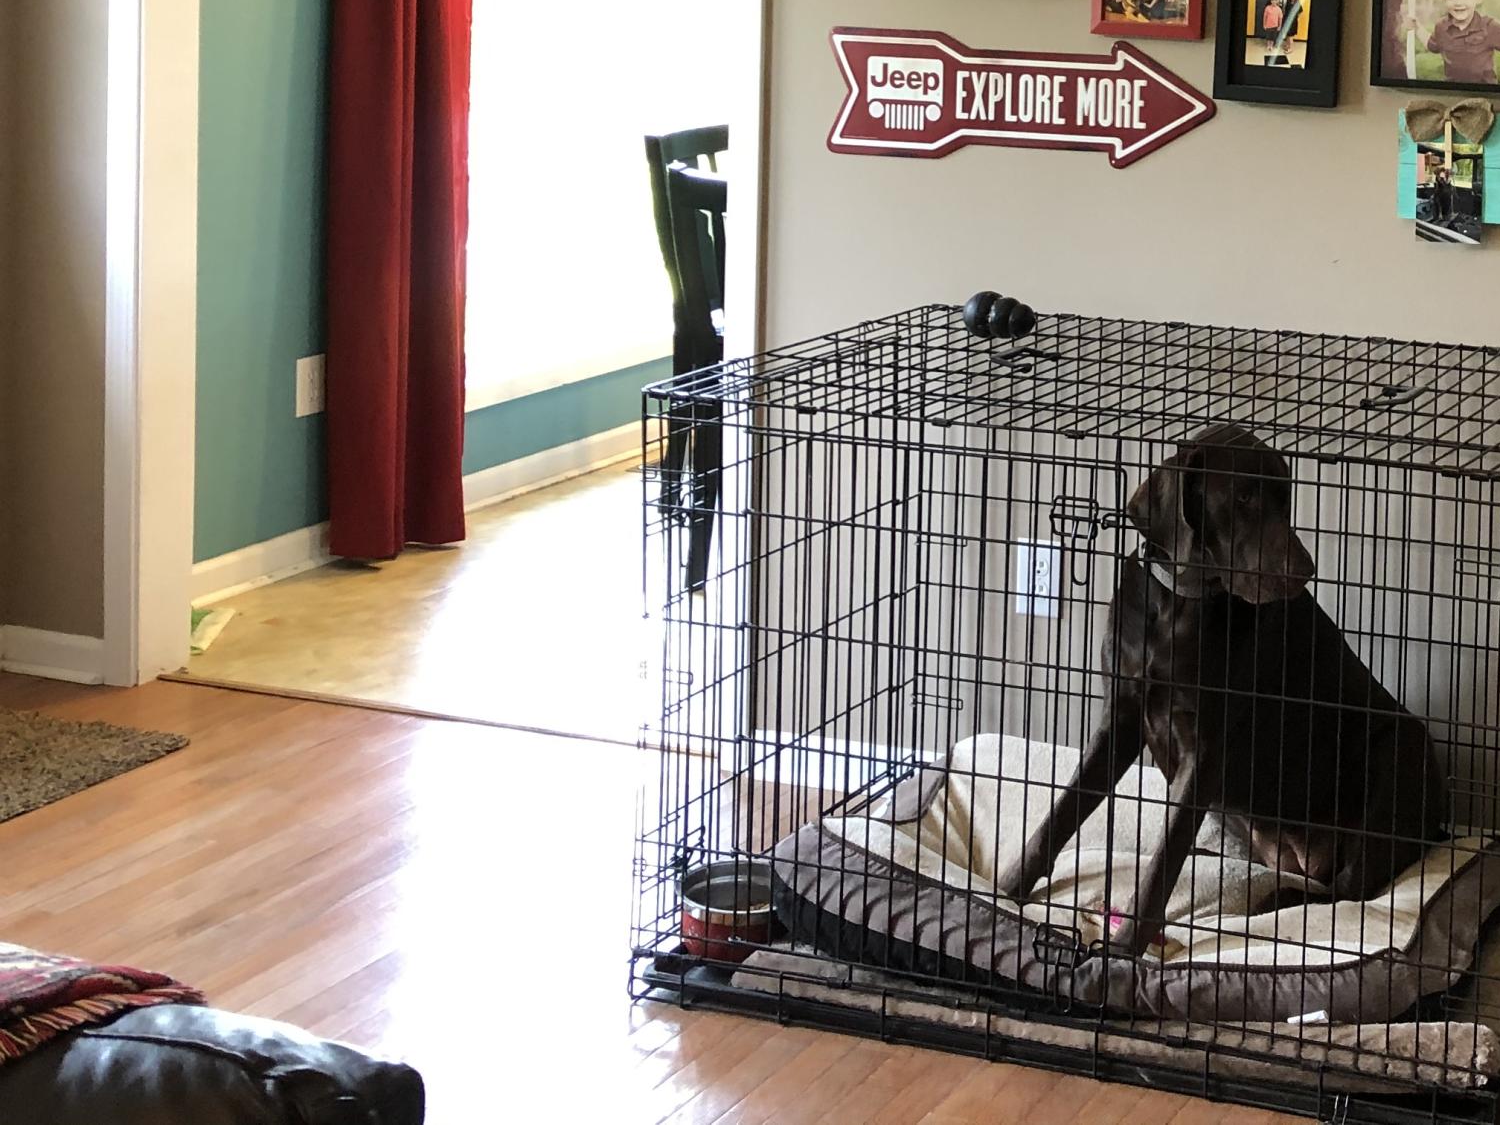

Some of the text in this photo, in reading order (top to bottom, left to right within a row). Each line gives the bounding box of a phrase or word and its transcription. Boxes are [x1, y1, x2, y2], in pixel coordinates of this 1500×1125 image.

[870, 62, 940, 93] Jeep
[955, 70, 1148, 129] EXPLORE MORE
